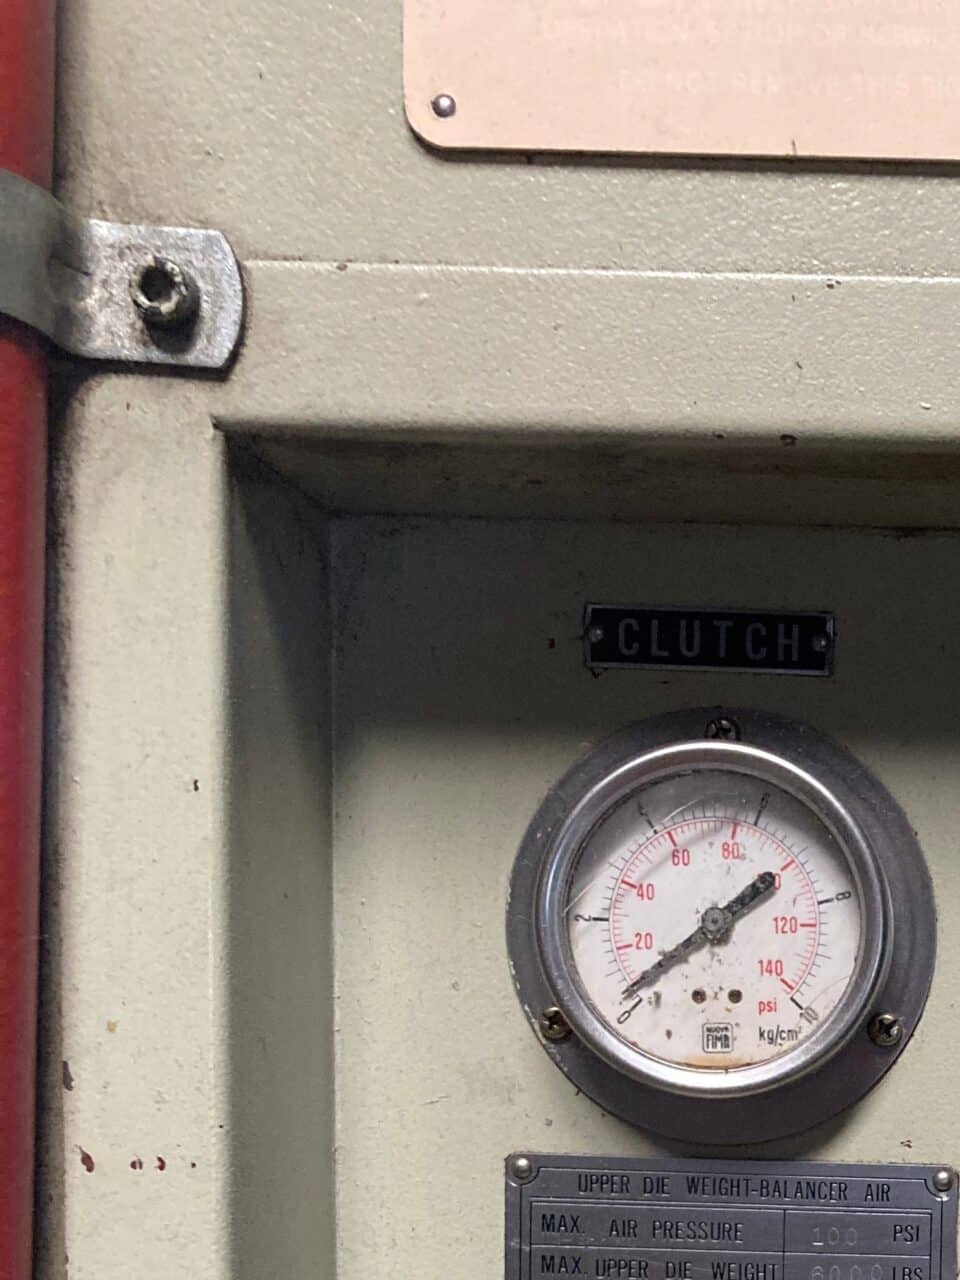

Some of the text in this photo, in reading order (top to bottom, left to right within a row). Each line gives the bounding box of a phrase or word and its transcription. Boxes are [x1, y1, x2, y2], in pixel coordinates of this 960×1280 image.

[618, 618, 800, 662] CLUTCH
[672, 850, 690, 866] 60
[721, 843, 740, 860] 80
[636, 884, 655, 900] 40
[773, 917, 798, 934] 120
[635, 933, 653, 950] 20
[758, 960, 783, 977] 140
[758, 998, 777, 1016] psi
[617, 1011, 631, 1024] 0
[578, 1174, 891, 1202] UPPER DIE WEIGHT-BALANCER AIR
[541, 1213, 920, 1246] MAX. AIR PRESSURE 100 PSI
[541, 1255, 588, 1274] MAX.
[595, 1258, 649, 1279] UPPER
[665, 1261, 693, 1280] DIE
